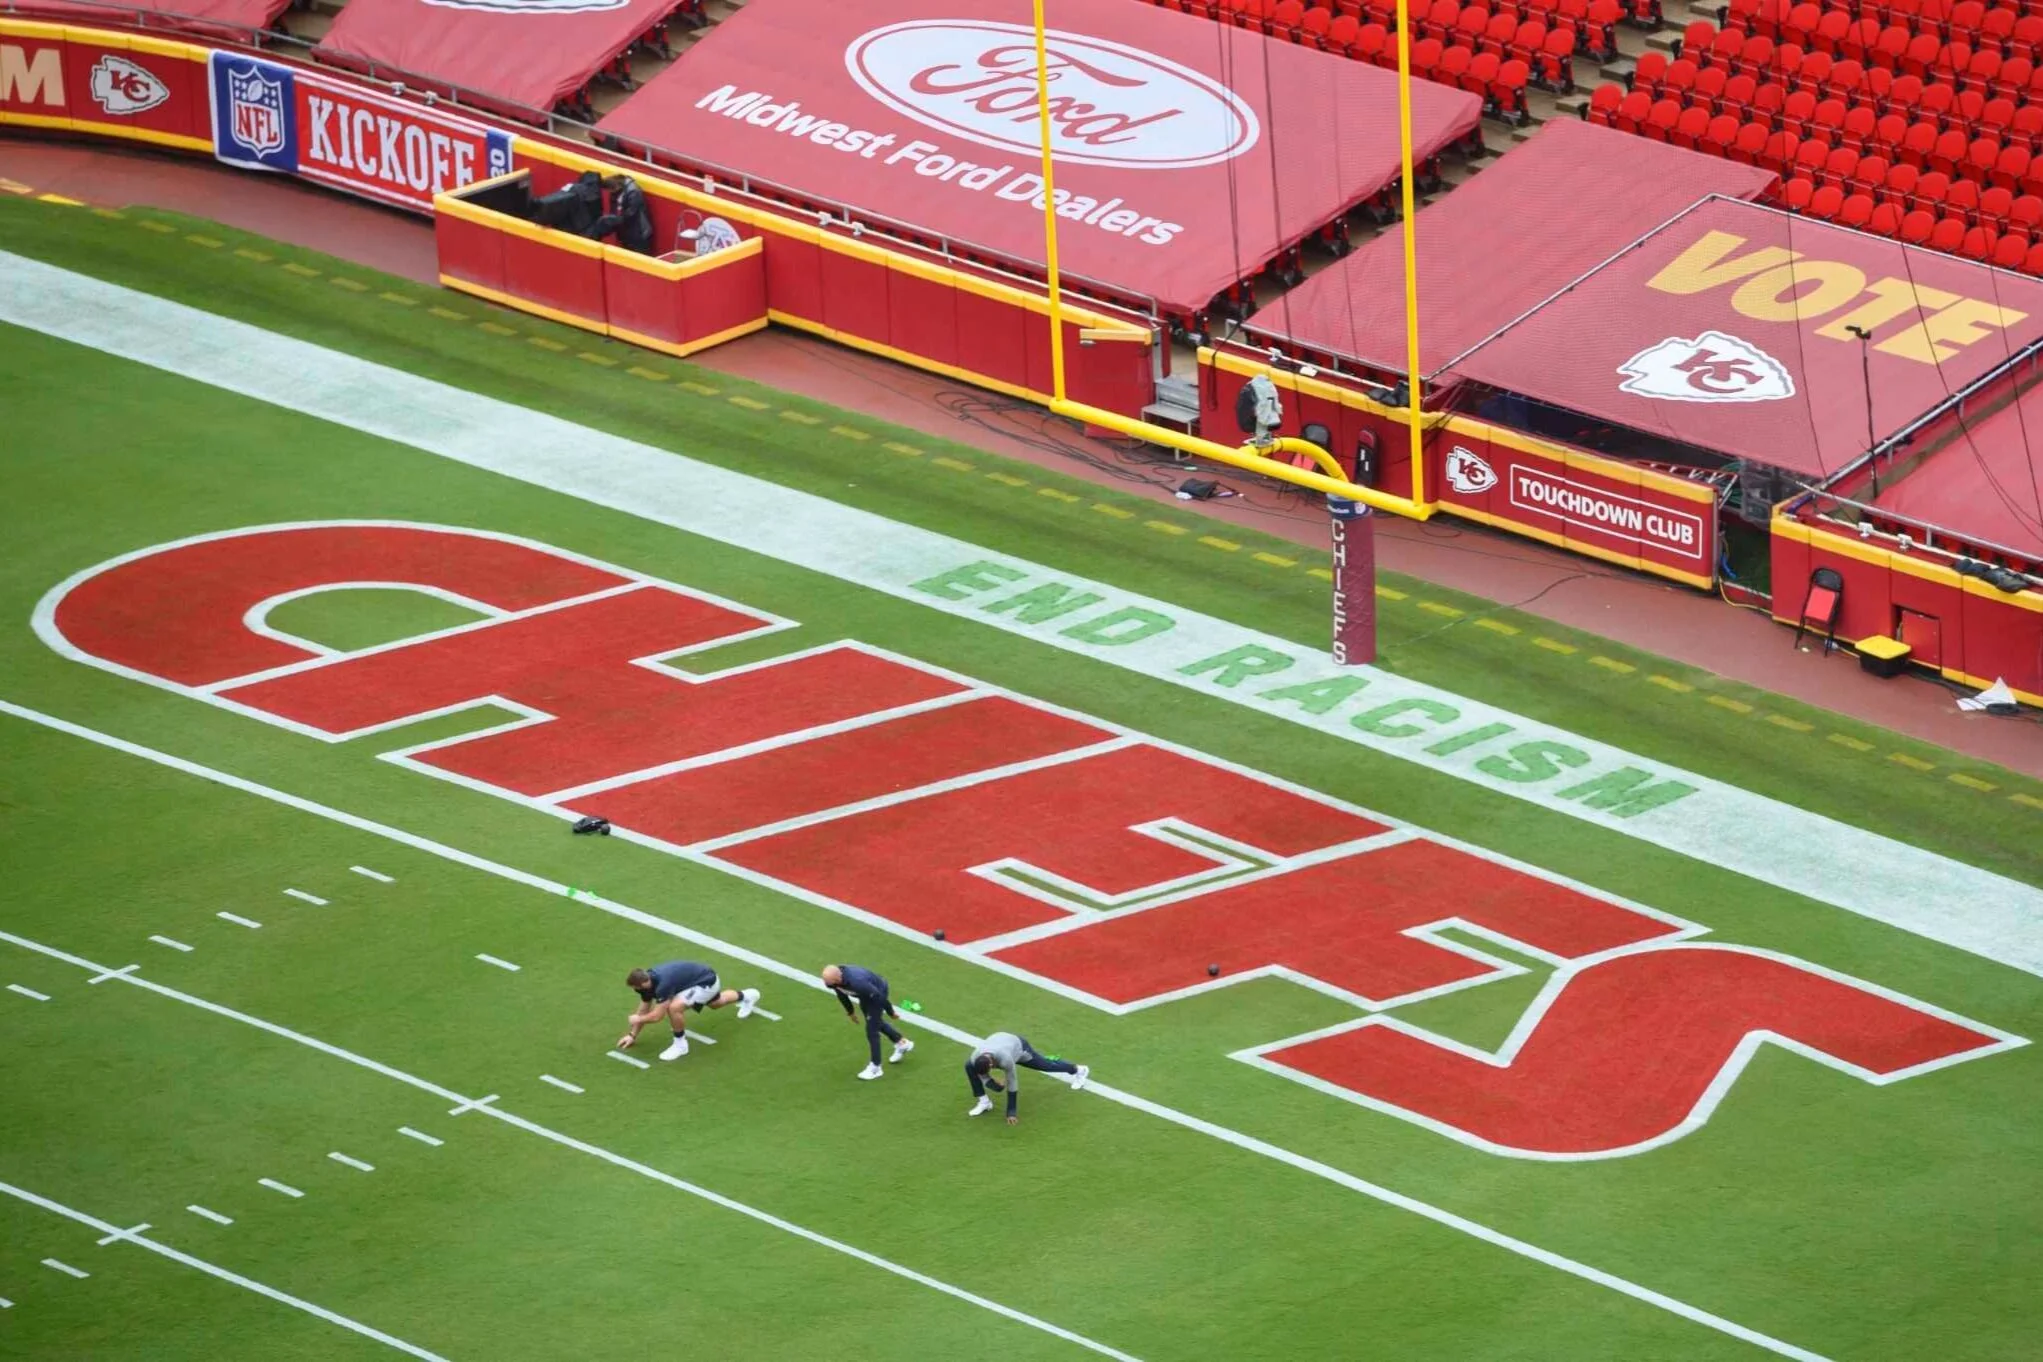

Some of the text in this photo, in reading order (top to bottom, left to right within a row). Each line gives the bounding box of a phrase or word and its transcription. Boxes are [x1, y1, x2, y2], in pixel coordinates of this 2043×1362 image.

[110, 70, 151, 102] KC
[237, 104, 278, 144] NFL
[909, 45, 1184, 145] Ford
[308, 95, 475, 194] KICKOFF
[695, 84, 1184, 245] Midwest Ford Dealers
[1645, 230, 2029, 366] VOTE
[1670, 349, 1764, 394] KC
[1458, 457, 1486, 486] KC
[1518, 476, 1694, 545] TOUCHDOWN CLUB
[1331, 518, 1347, 666] CHIEFS
[907, 560, 1699, 819] END RACISM
[30, 519, 2033, 1161] CHIEFS
